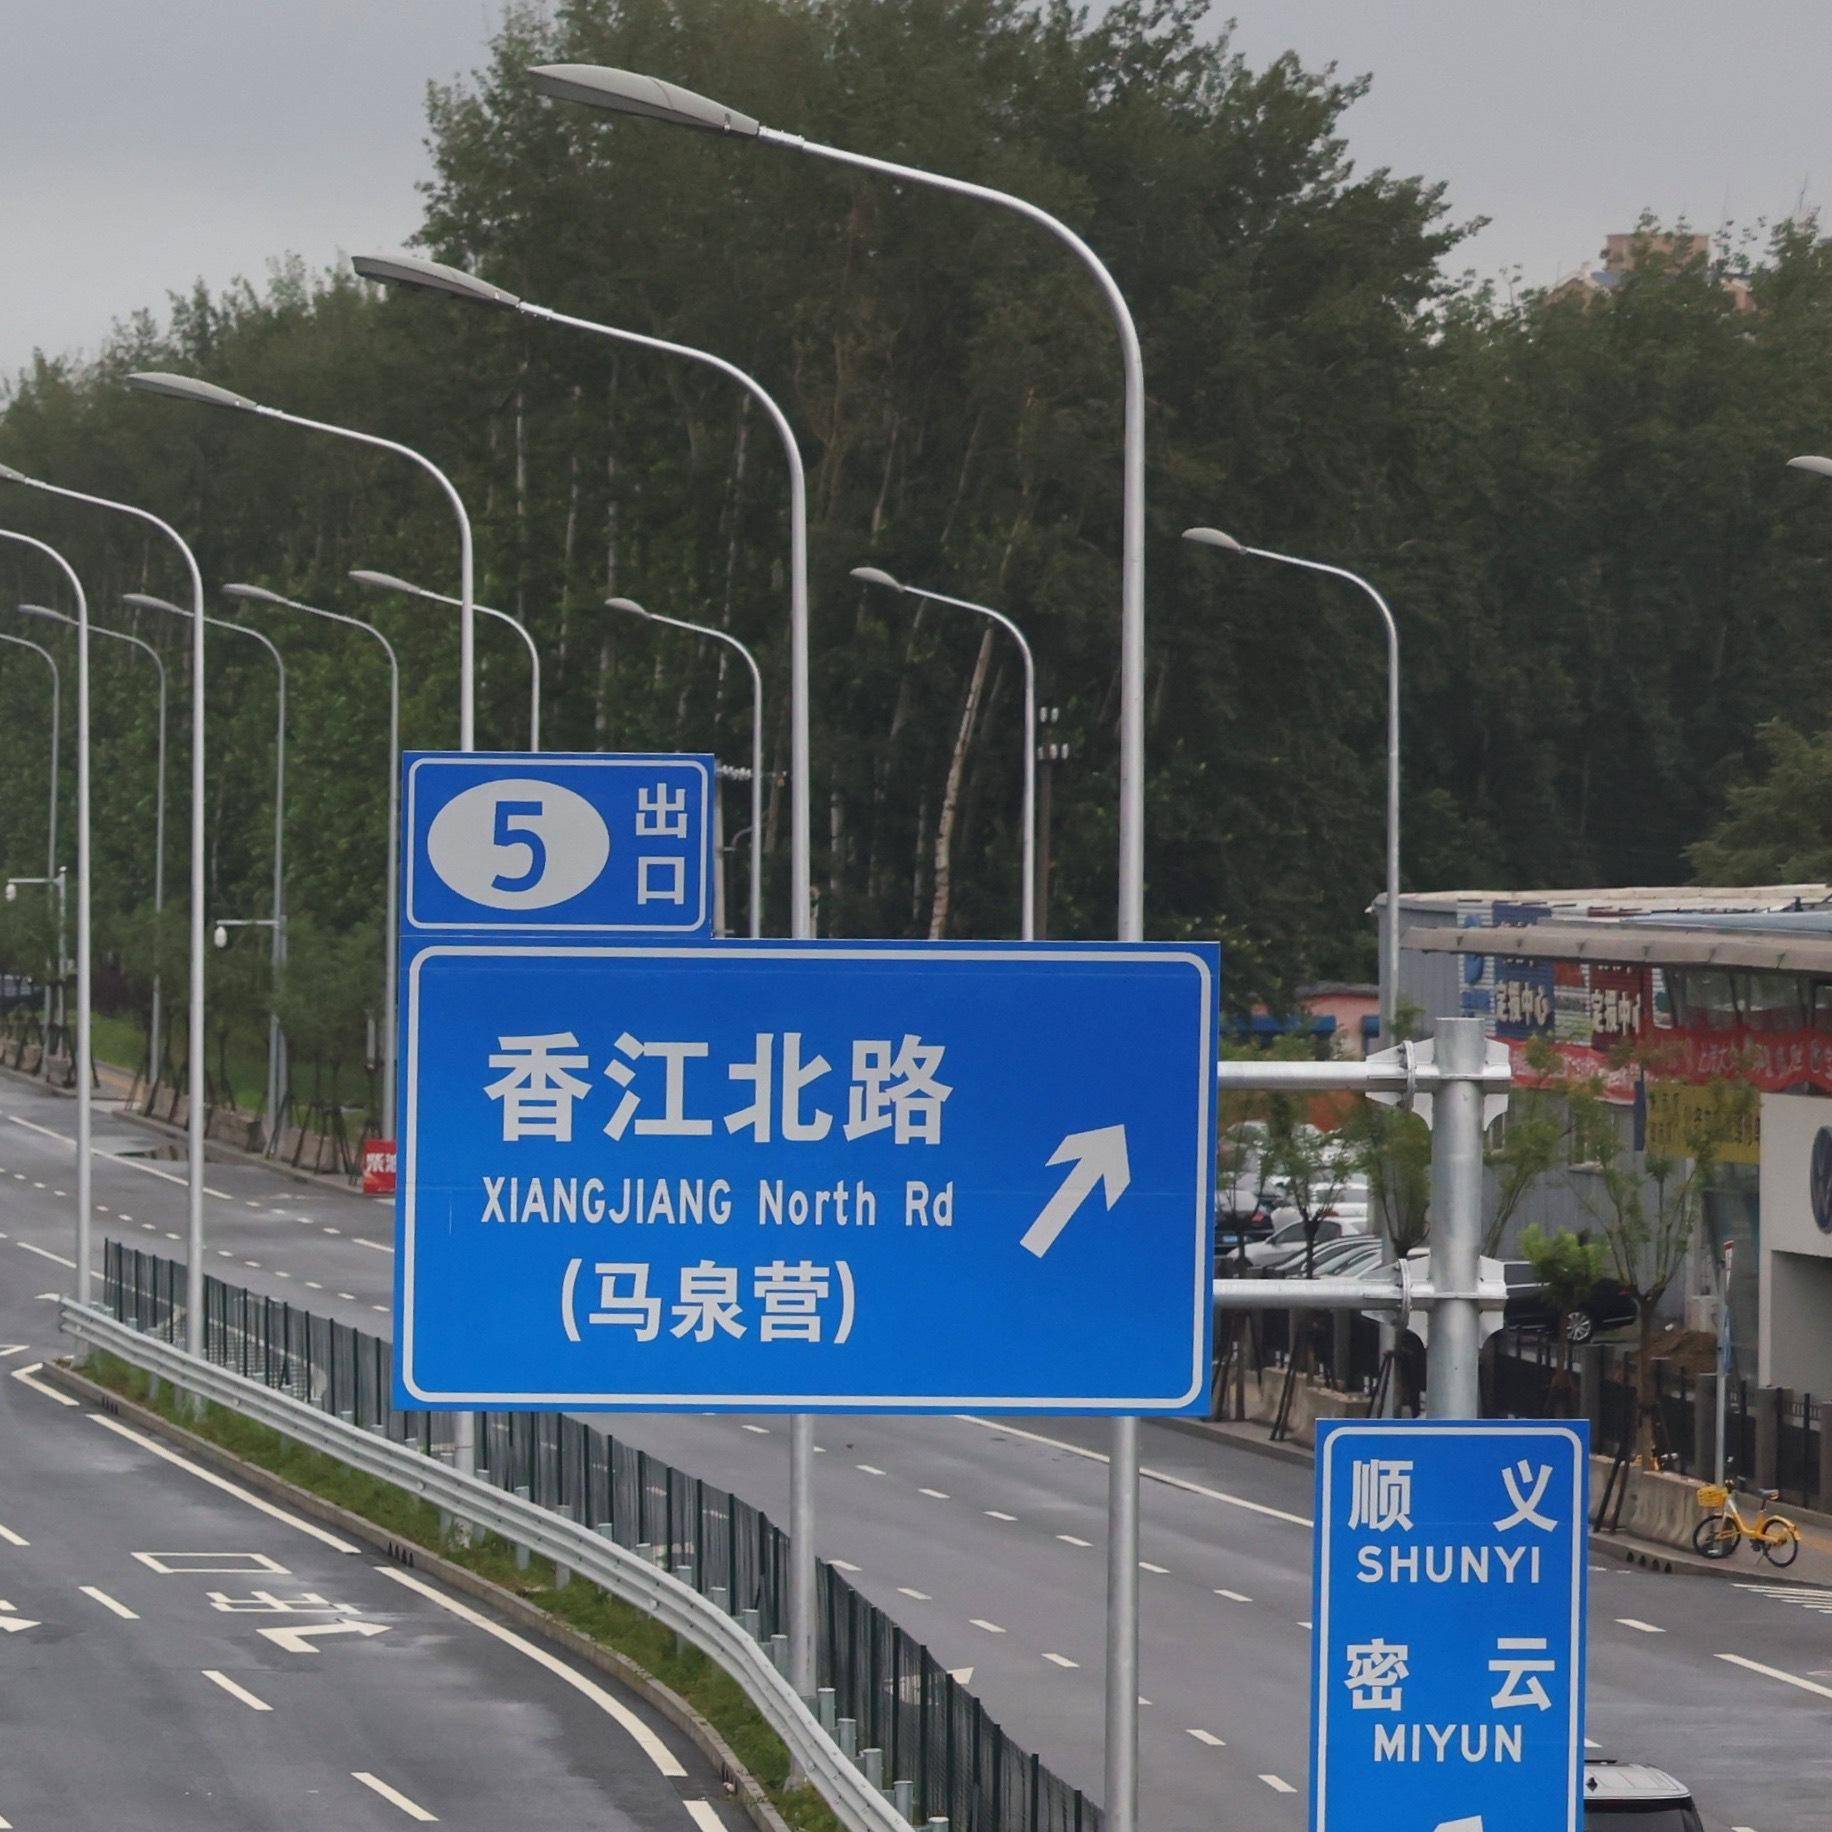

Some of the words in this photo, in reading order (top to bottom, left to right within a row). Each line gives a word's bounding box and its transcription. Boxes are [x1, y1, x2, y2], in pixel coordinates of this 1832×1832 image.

[490, 800, 547, 893] 5
[635, 782, 688, 905] 出口
[483, 1031, 954, 1145] 香江北路
[481, 1176, 732, 1225] XIANGJIANG
[758, 1179, 876, 1226] North
[905, 1180, 954, 1227] Rd
[561, 1258, 855, 1344] (马泉营)
[1356, 1545, 1540, 1584] SHUNYI
[1374, 1723, 1523, 1763] MIYUN
